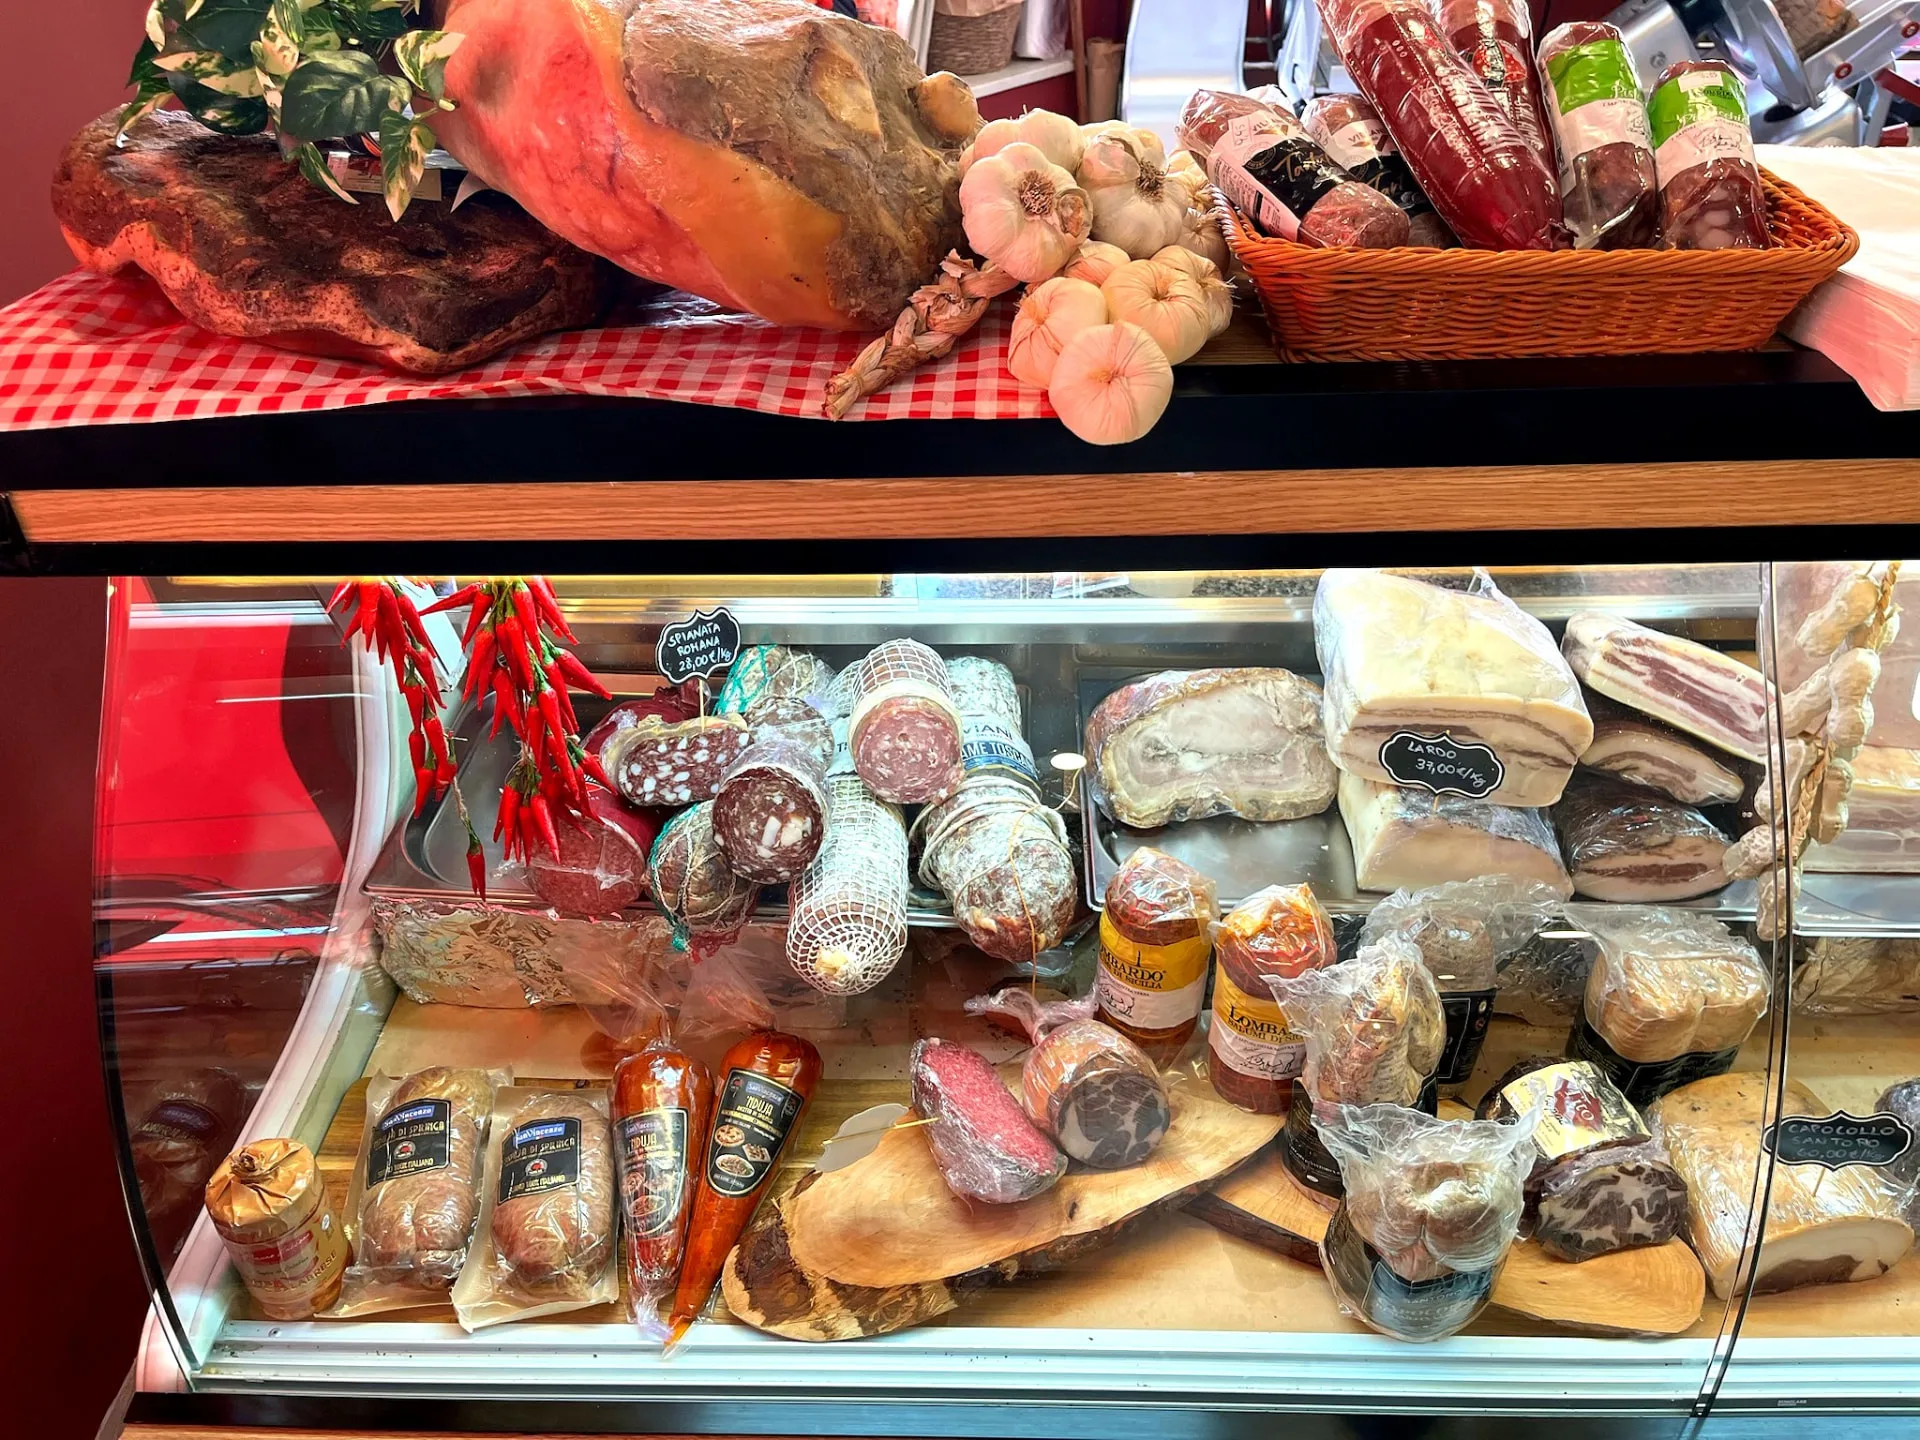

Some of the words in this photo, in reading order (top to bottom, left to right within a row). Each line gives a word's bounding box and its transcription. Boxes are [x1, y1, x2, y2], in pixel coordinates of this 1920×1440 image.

[667, 622, 721, 648] SPIANATA
[676, 636, 720, 656] ROMANA
[1407, 741, 1457, 759] LARDO
[1228, 1003, 1293, 1036] LOMBA
[1788, 1124, 1896, 1136] CAPOCOLLO
